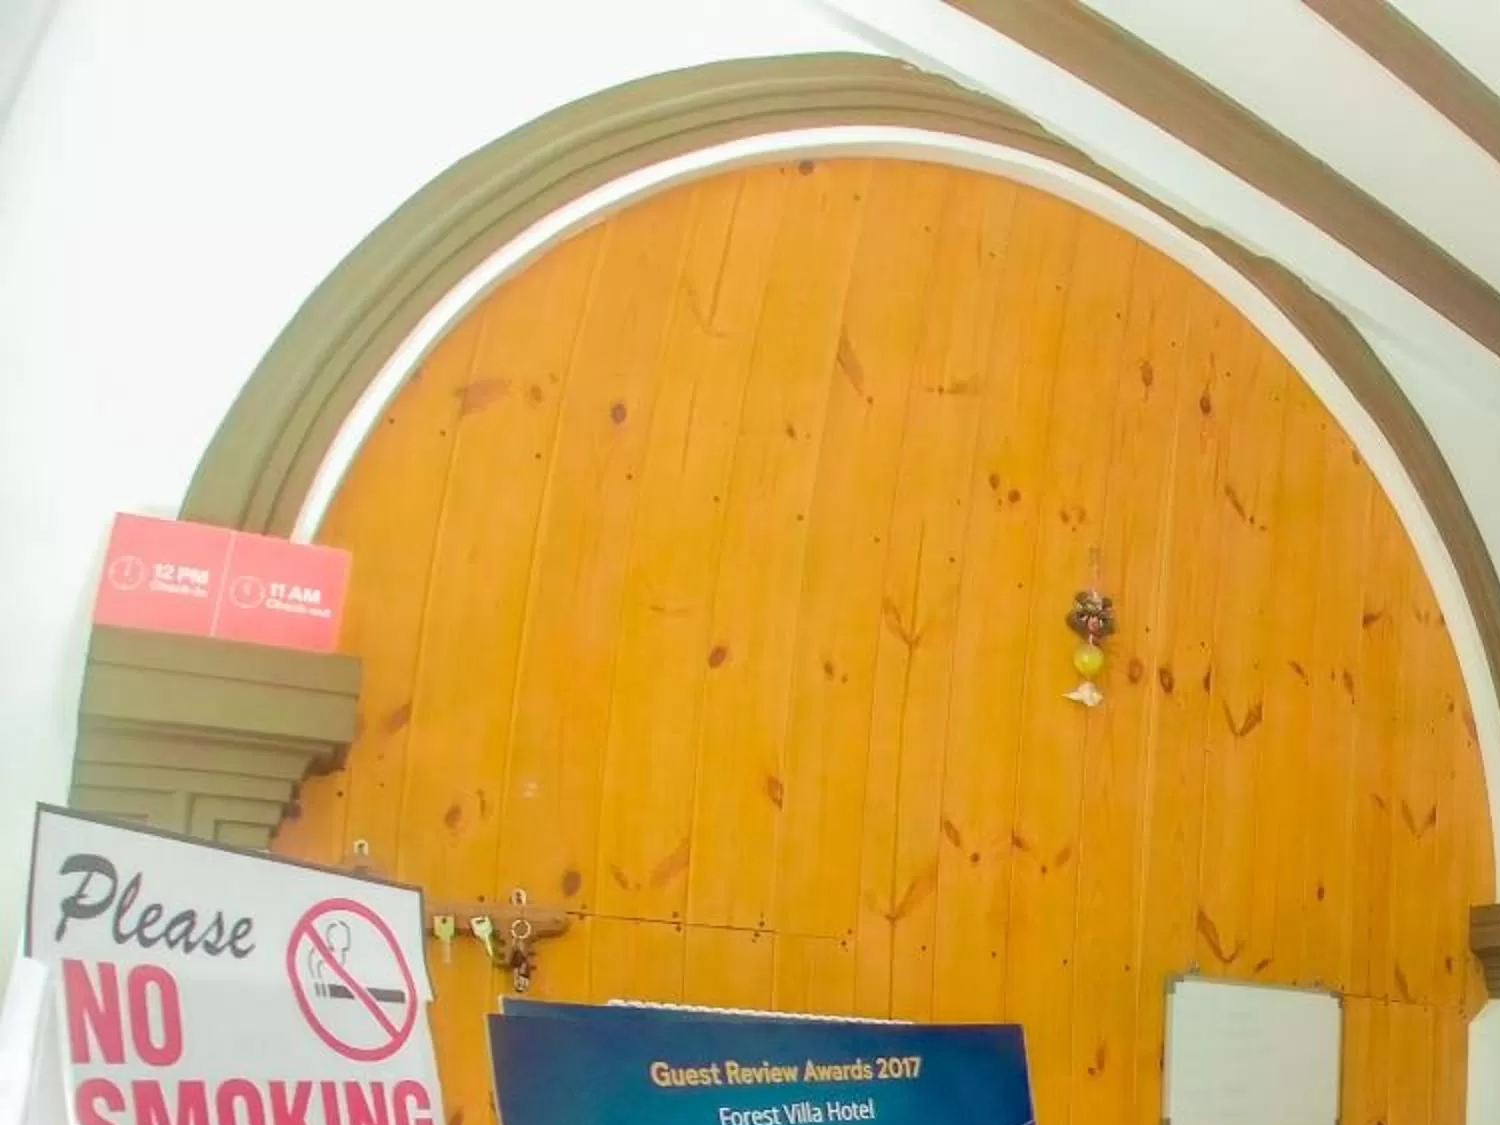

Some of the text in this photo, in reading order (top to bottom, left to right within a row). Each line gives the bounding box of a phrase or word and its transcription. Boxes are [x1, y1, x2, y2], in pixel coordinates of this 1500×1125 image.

[288, 586, 321, 605] AM
[55, 853, 256, 958] Please
[61, 958, 184, 1067] NO
[651, 1056, 922, 1088] Guest Review Awards 2017
[781, 1102, 823, 1125] Villa
[827, 1097, 876, 1123] Hotel
